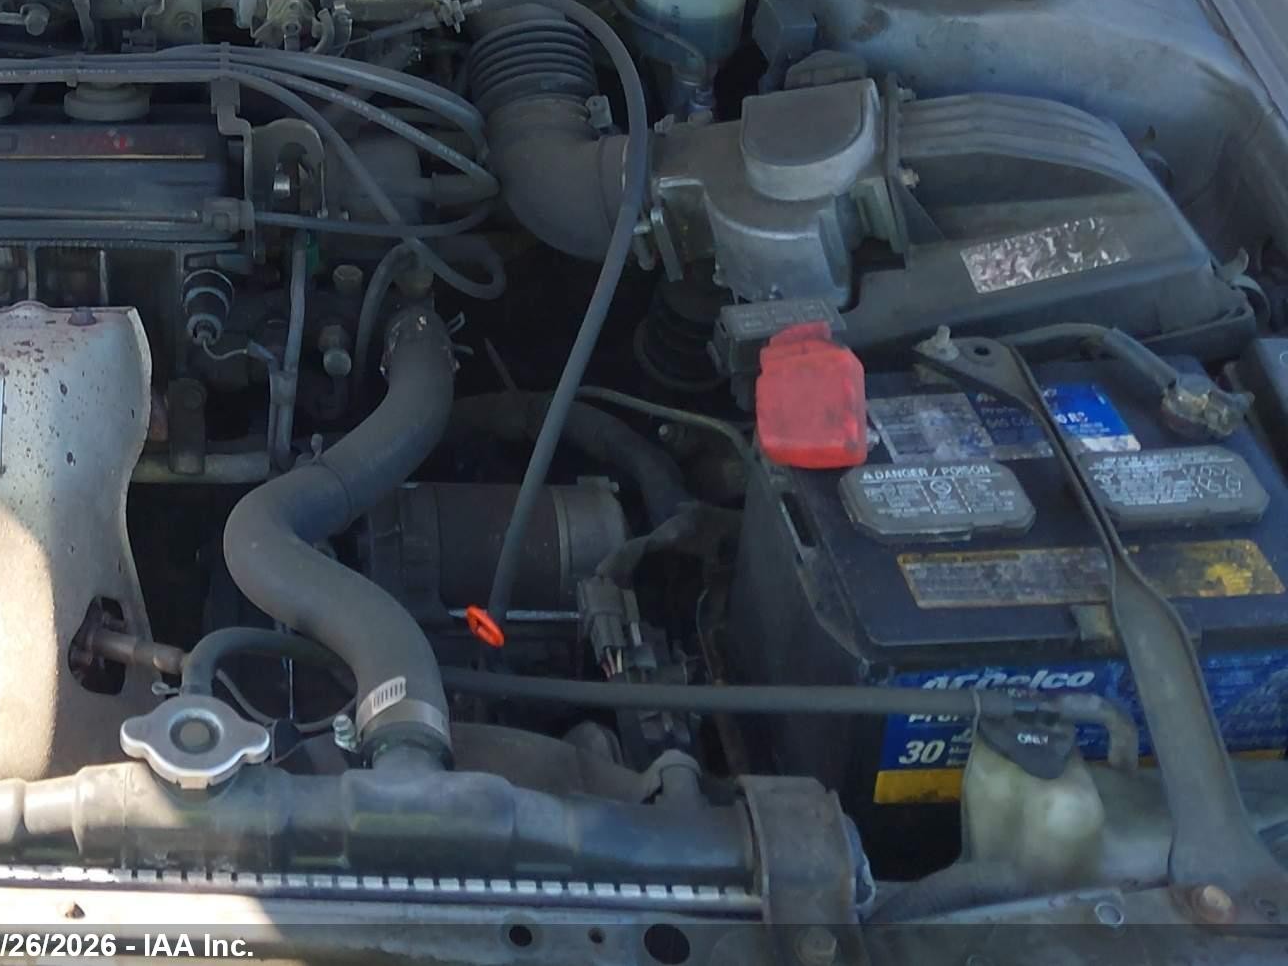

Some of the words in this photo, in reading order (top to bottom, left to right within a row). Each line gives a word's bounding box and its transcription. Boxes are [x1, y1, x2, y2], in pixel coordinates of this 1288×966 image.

[876, 467, 927, 480] DANGER
[941, 465, 992, 476] POISON
[898, 739, 946, 765] 30
